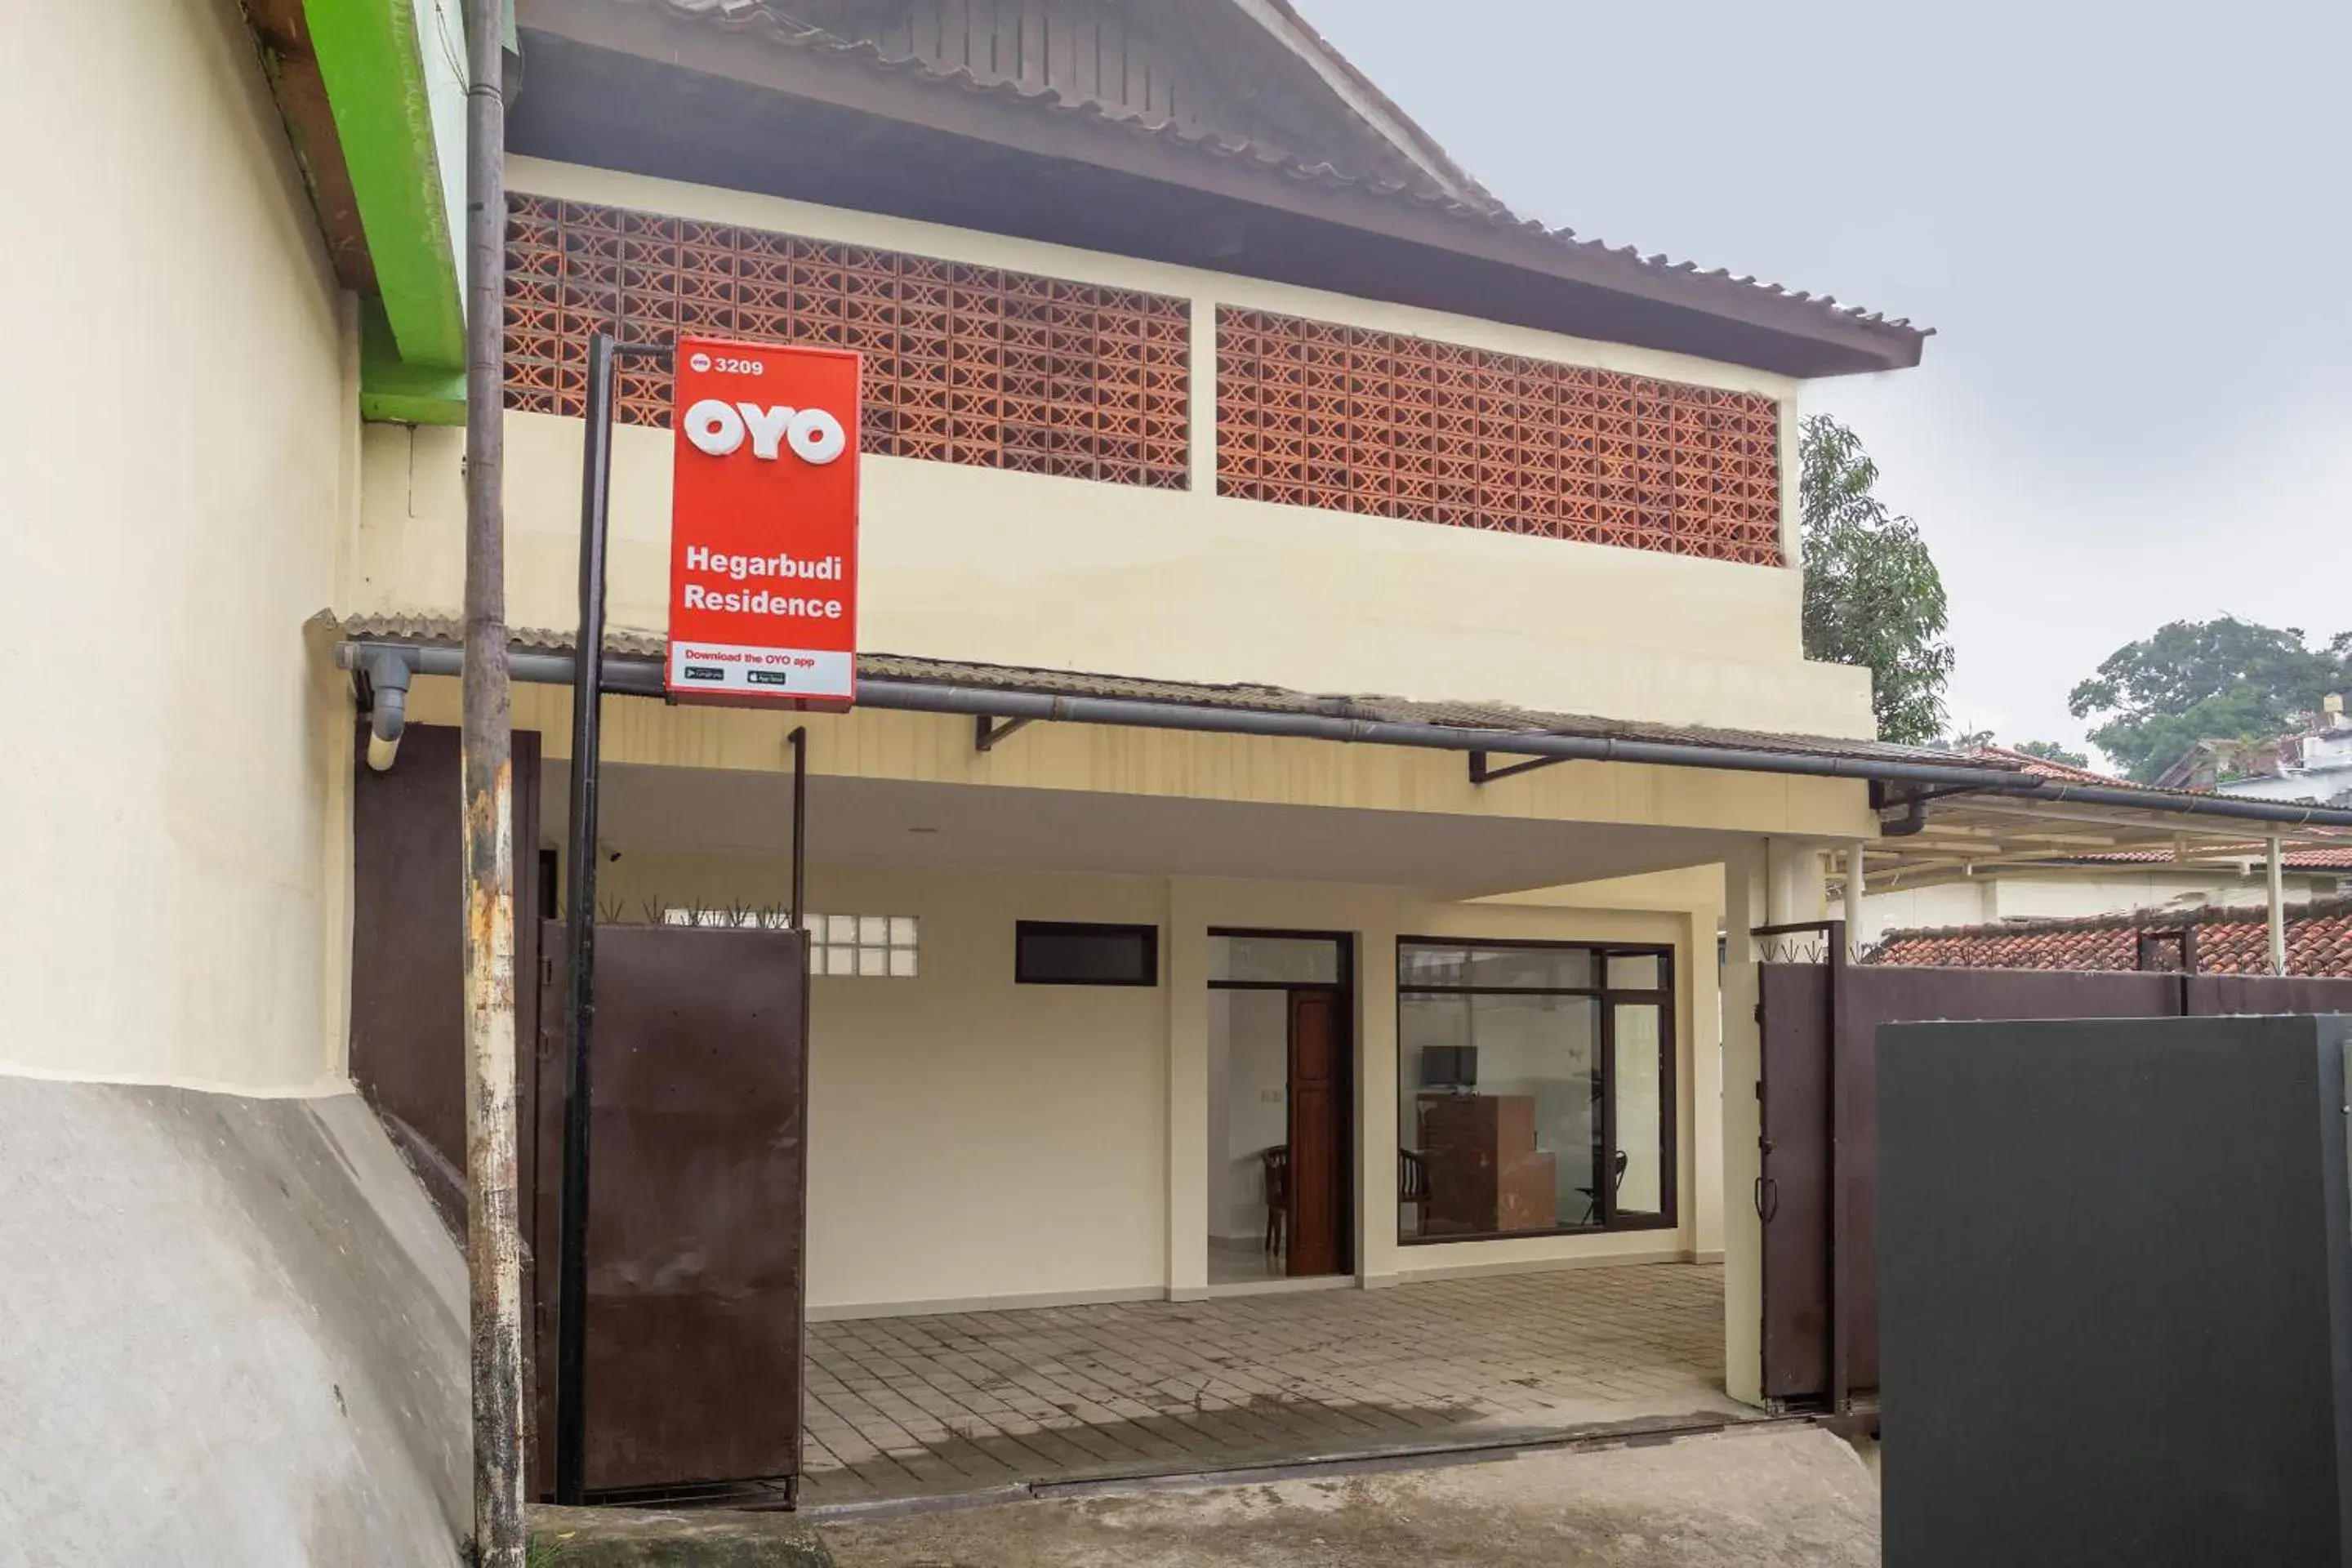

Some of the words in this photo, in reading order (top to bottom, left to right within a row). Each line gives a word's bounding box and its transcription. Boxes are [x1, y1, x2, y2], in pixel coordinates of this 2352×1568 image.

[715, 358, 764, 375] 3209
[684, 399, 846, 465] OYO
[687, 546, 842, 580] Hegarbudi
[684, 584, 842, 618] Residence
[685, 649, 742, 662] Download
[744, 654, 763, 663] the
[766, 655, 791, 665] OYO
[794, 657, 815, 668] app
